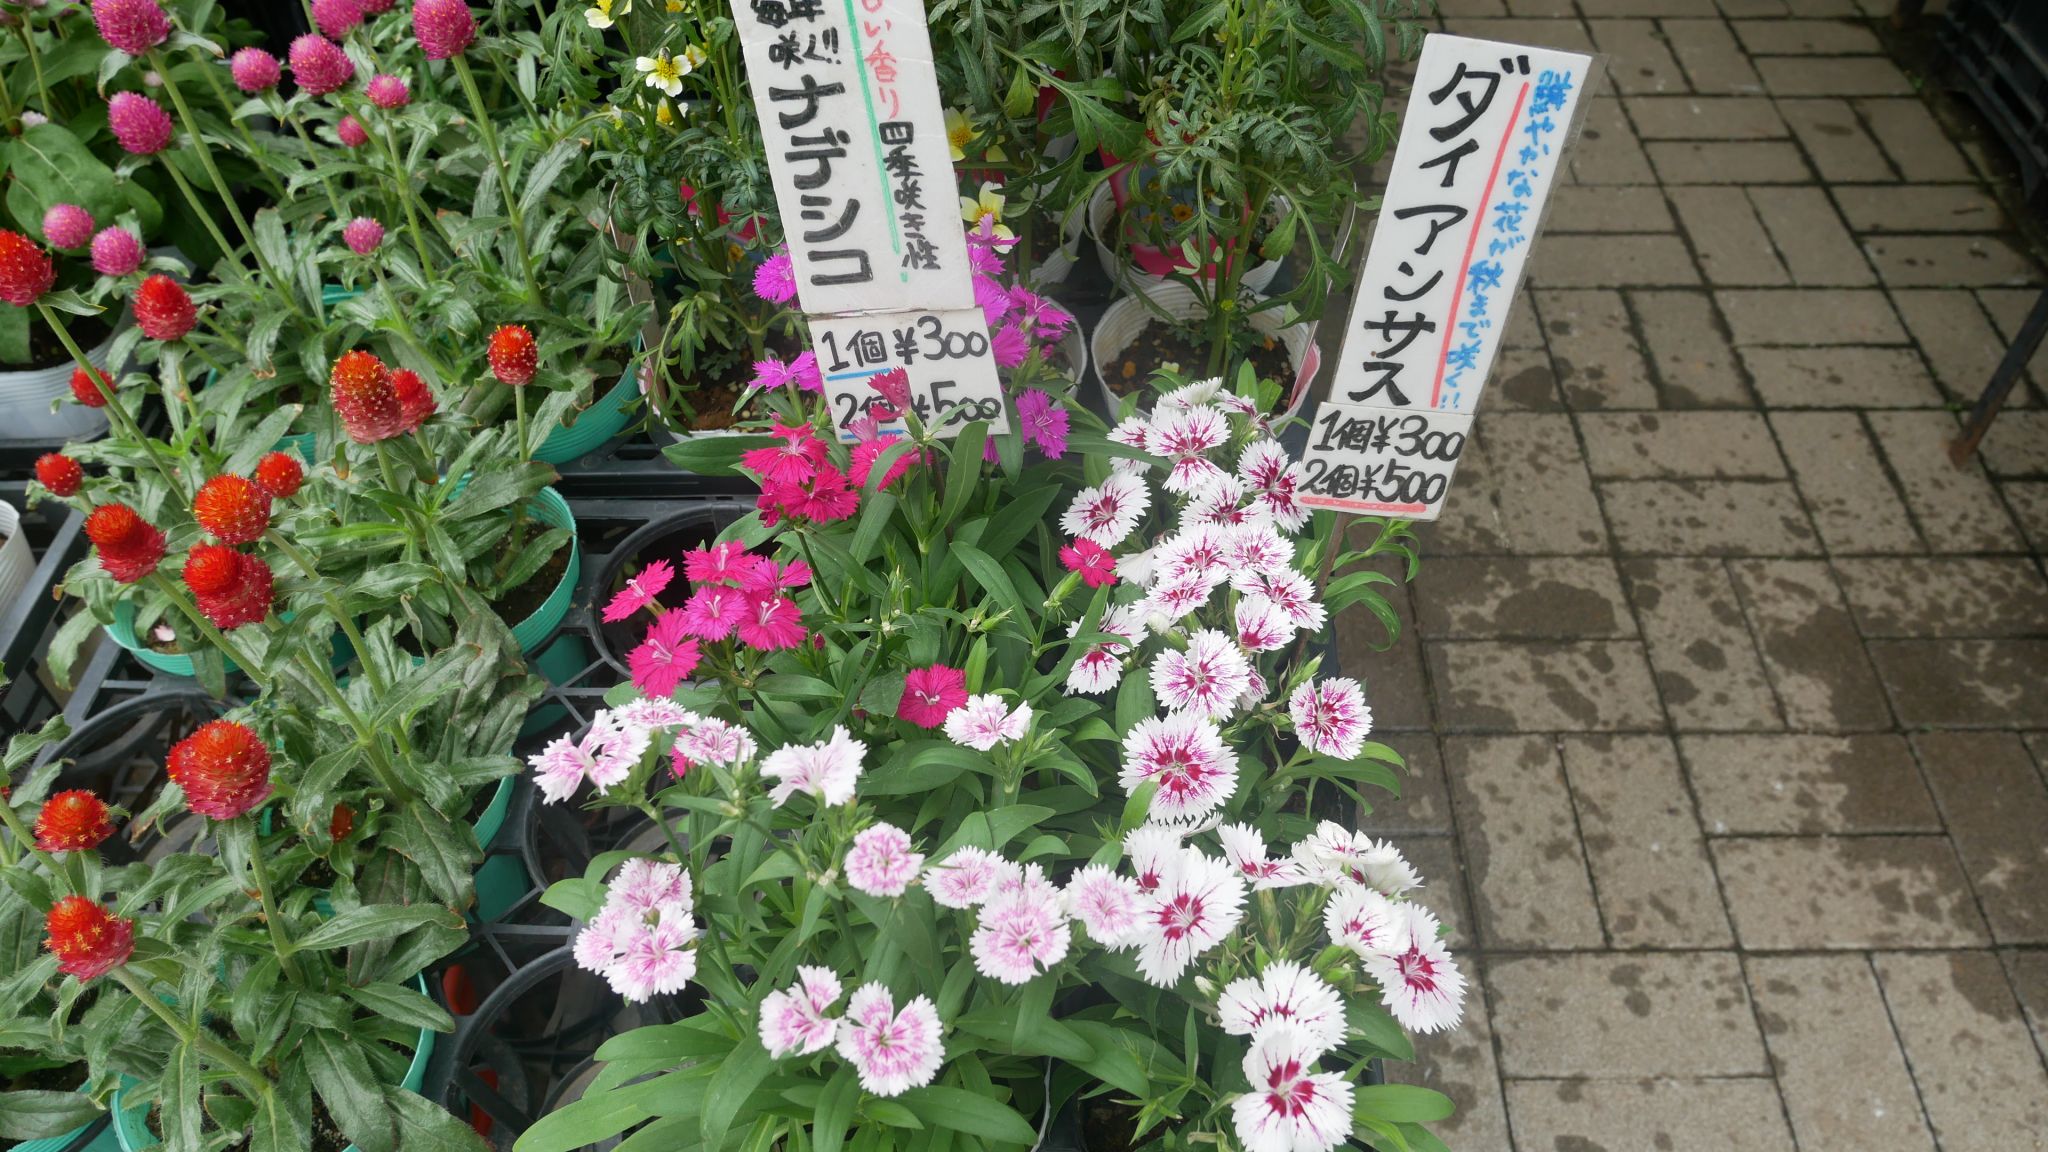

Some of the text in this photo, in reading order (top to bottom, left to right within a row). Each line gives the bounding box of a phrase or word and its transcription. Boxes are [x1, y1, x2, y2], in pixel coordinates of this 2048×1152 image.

[769, 75, 873, 286] ナデシコ
[879, 122, 941, 269] 四季咲き性
[1347, 55, 1530, 406] ダイアンサス
[1298, 458, 1448, 504] 2個¥500
[1312, 409, 1466, 462] 1個¥300
